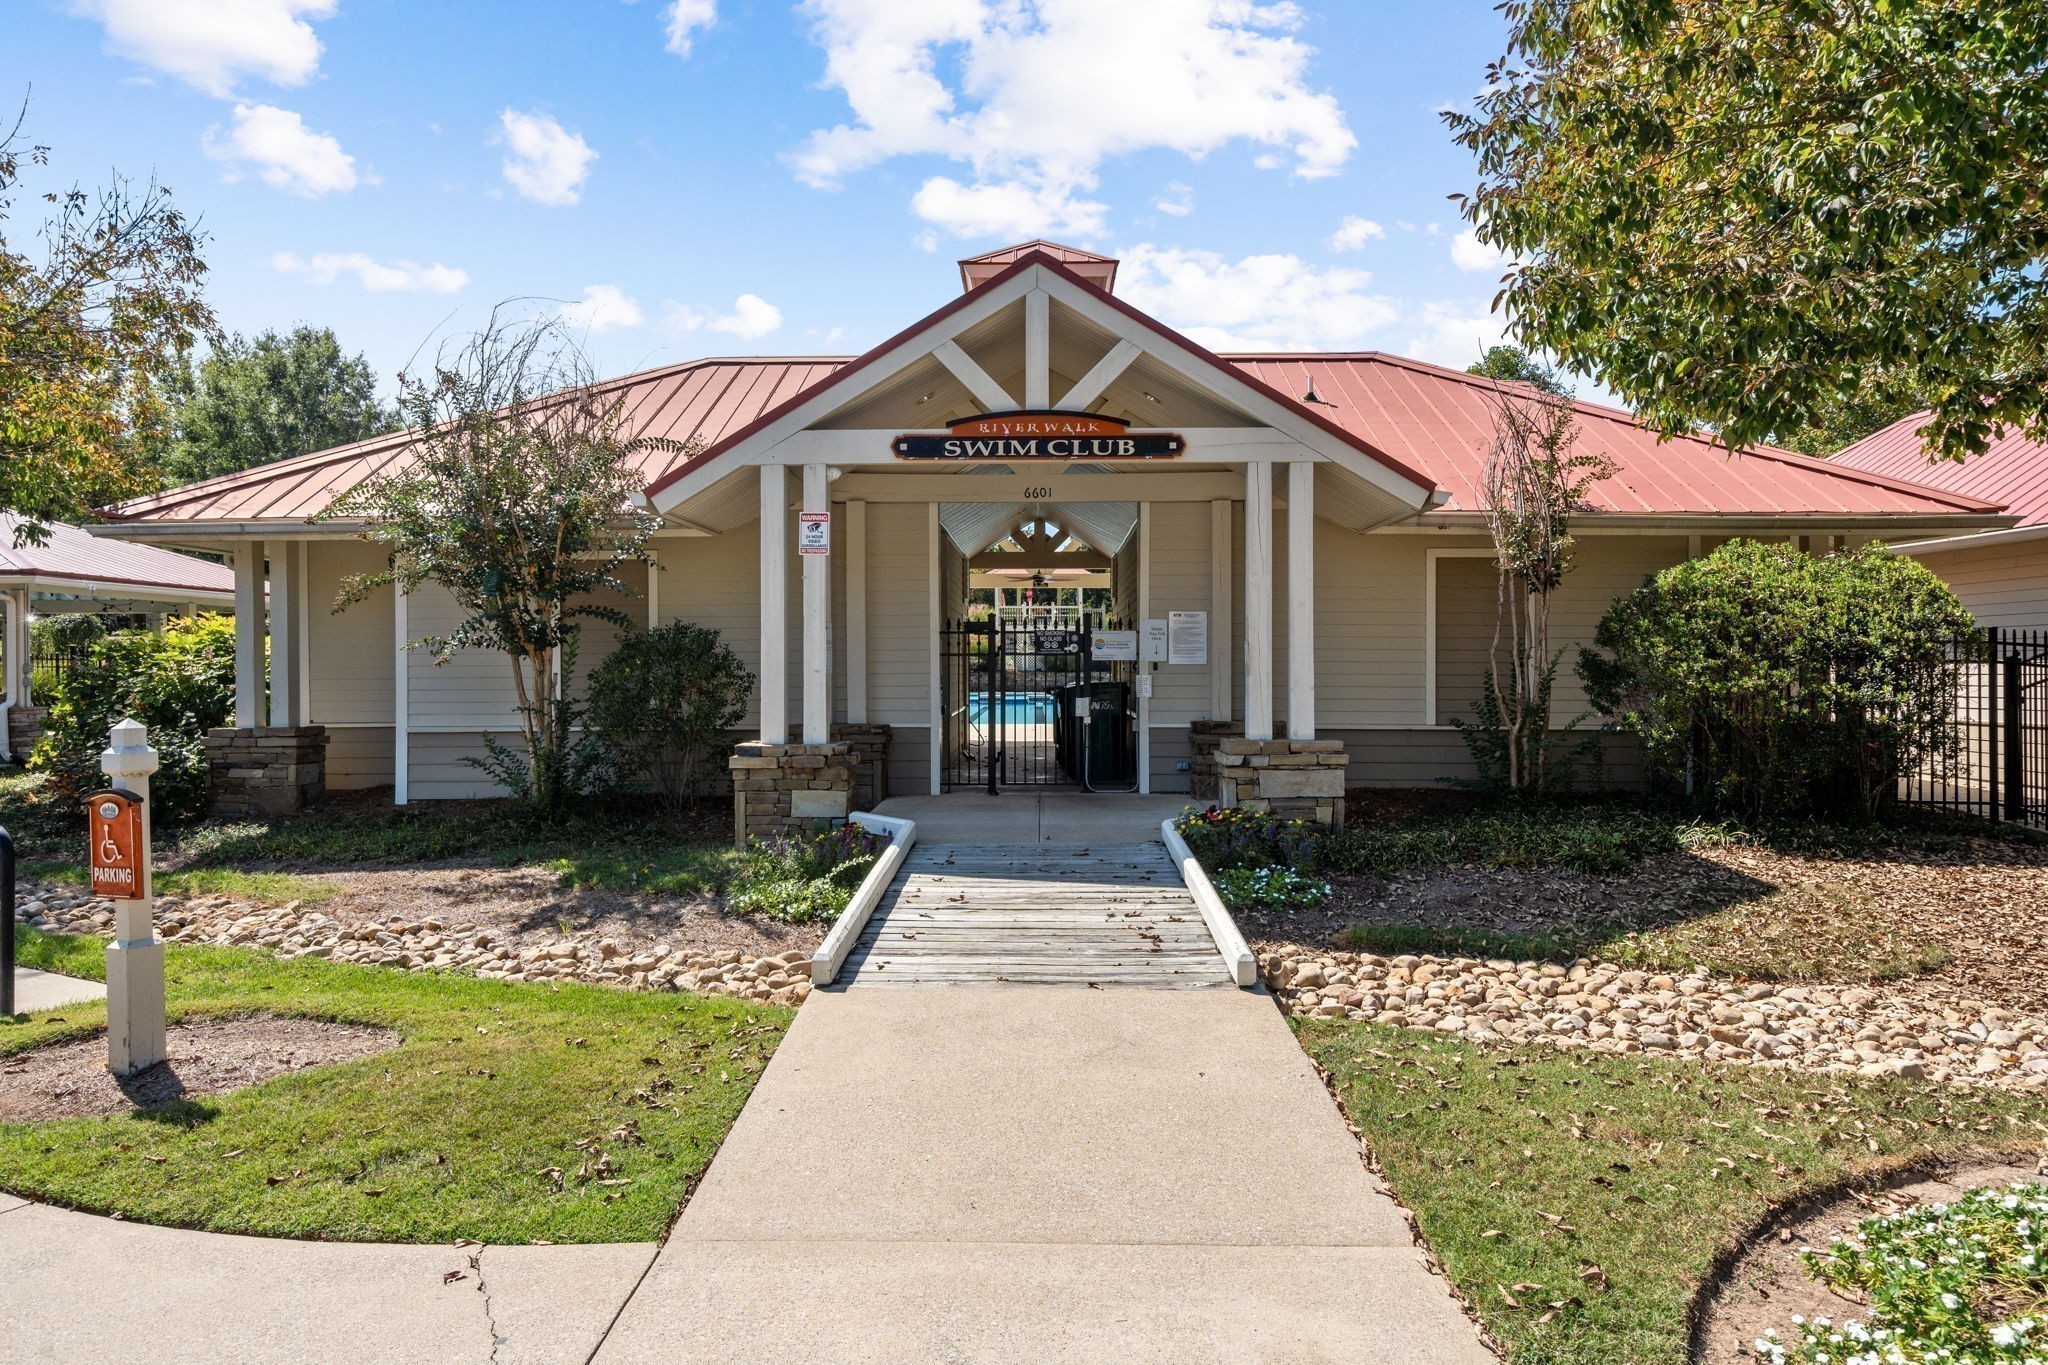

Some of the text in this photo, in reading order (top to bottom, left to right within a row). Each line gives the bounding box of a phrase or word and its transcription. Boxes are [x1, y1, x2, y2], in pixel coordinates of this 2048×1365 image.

[944, 439, 1135, 457] SWIM CLUB
[1023, 487, 1053, 498] 6601
[94, 867, 132, 883] PARKING
